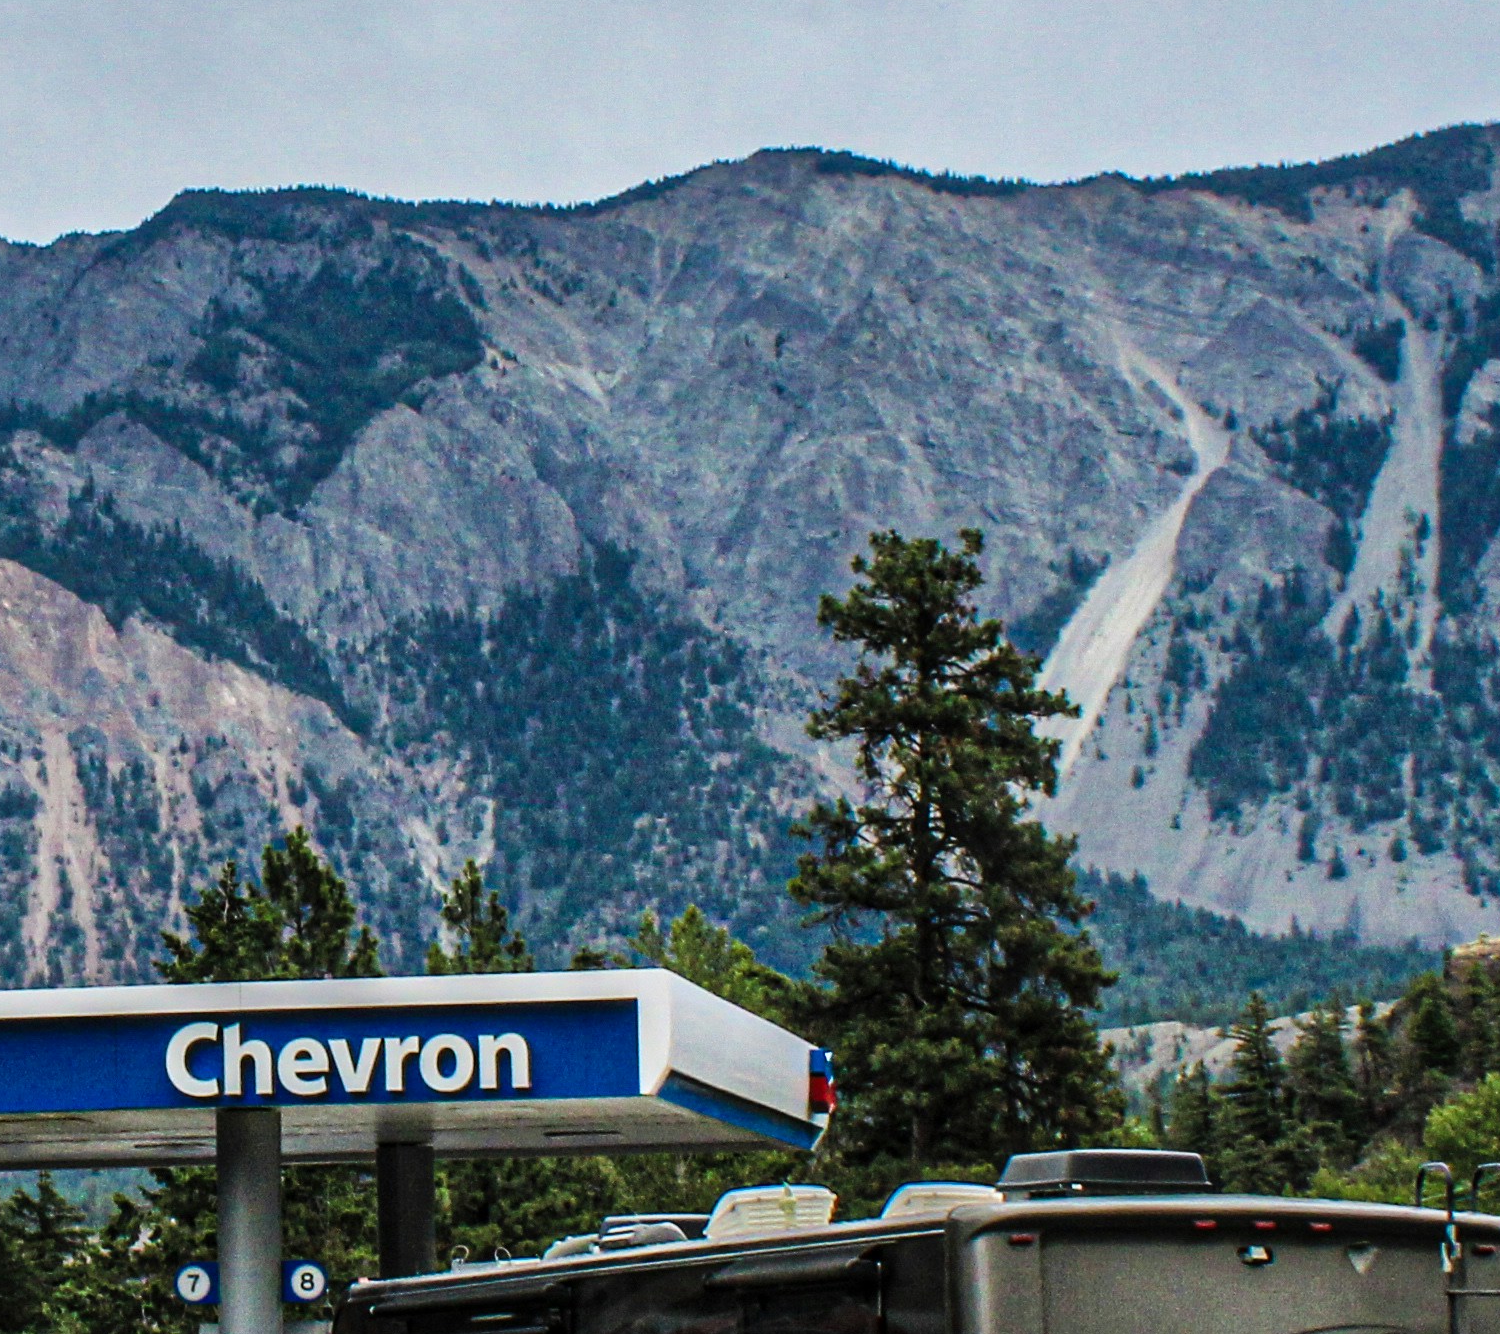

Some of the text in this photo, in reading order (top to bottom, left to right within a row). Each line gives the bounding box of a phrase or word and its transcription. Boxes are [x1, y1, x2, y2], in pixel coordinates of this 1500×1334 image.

[165, 1021, 532, 1097] Chevron
[187, 1274, 200, 1293] 7
[301, 1273, 314, 1291] 8
